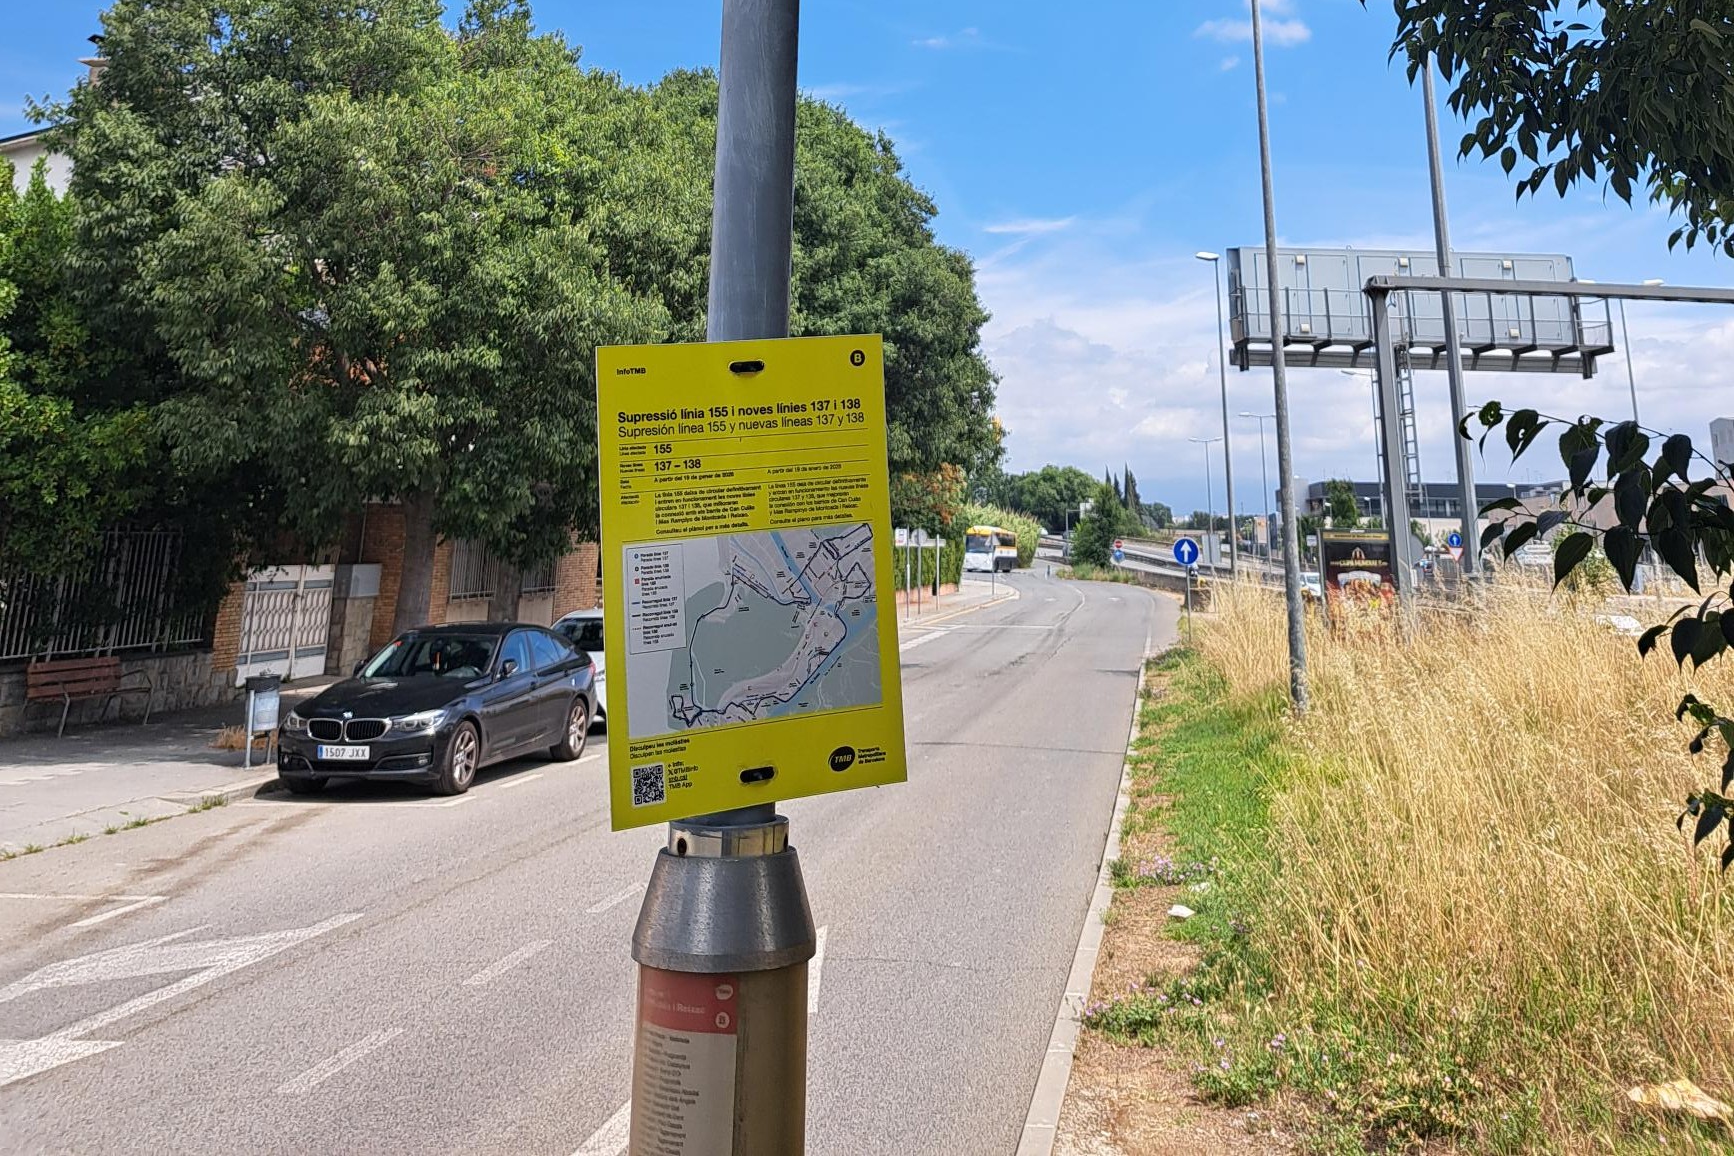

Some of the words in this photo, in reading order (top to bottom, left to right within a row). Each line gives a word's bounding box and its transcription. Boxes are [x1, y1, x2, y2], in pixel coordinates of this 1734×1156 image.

[854, 353, 862, 363] B
[618, 410, 676, 424] Supressió
[680, 409, 705, 420] línia
[708, 407, 729, 417] 155
[732, 406, 735, 416] i
[738, 406, 773, 416] noves
[777, 402, 807, 414] línies
[810, 401, 830, 412] 137
[834, 400, 837, 410] i
[841, 399, 860, 409] 138
[618, 424, 675, 439] Supresión
[678, 423, 704, 434] línea
[708, 422, 726, 432] 155
[730, 422, 736, 434] y
[739, 419, 778, 431] nuevas
[782, 416, 813, 428] líneas
[817, 414, 834, 425] 137
[838, 415, 844, 427] y
[848, 412, 864, 423] 138
[654, 444, 672, 454] 155
[654, 461, 672, 471] 137
[684, 459, 701, 469] 138
[326, 748, 345, 757] 1507
[349, 748, 366, 757] JXX
[835, 755, 852, 763] TMB
